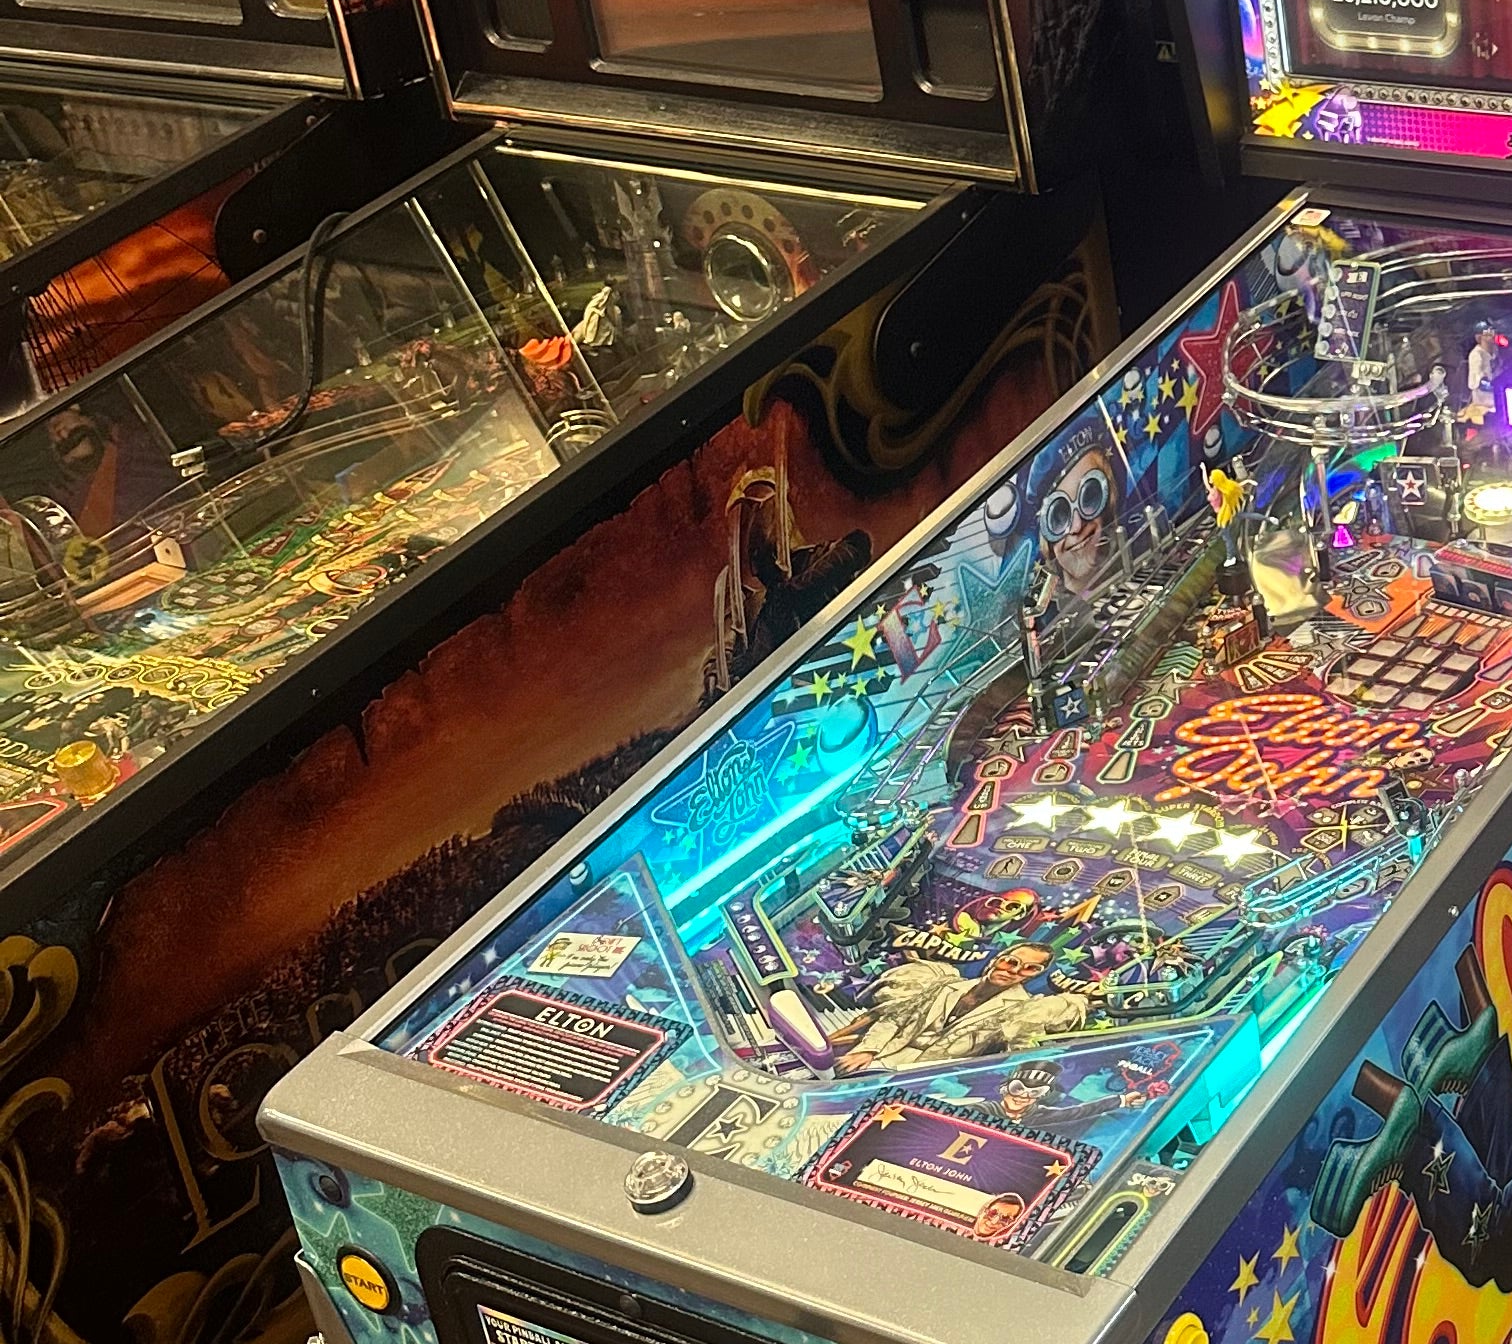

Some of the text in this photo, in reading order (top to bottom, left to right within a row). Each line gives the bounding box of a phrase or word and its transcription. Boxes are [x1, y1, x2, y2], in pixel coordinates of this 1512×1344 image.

[1059, 425, 1093, 462] ELTON
[1175, 693, 1426, 749] Elton
[1154, 741, 1386, 801] John
[1006, 842, 1032, 850] ONE
[1069, 845, 1097, 854] TWO
[1124, 854, 1155, 867] TOUR
[1179, 868, 1209, 883] THREE
[892, 929, 989, 961] CAPTAIN
[534, 1006, 614, 1039] ELTON
[1118, 1059, 1153, 1076] PINBALL
[936, 1131, 988, 1166] E
[908, 1158, 973, 1183] ELTON JOHN
[344, 1272, 385, 1295] START
[485, 1316, 511, 1334] YOUR
